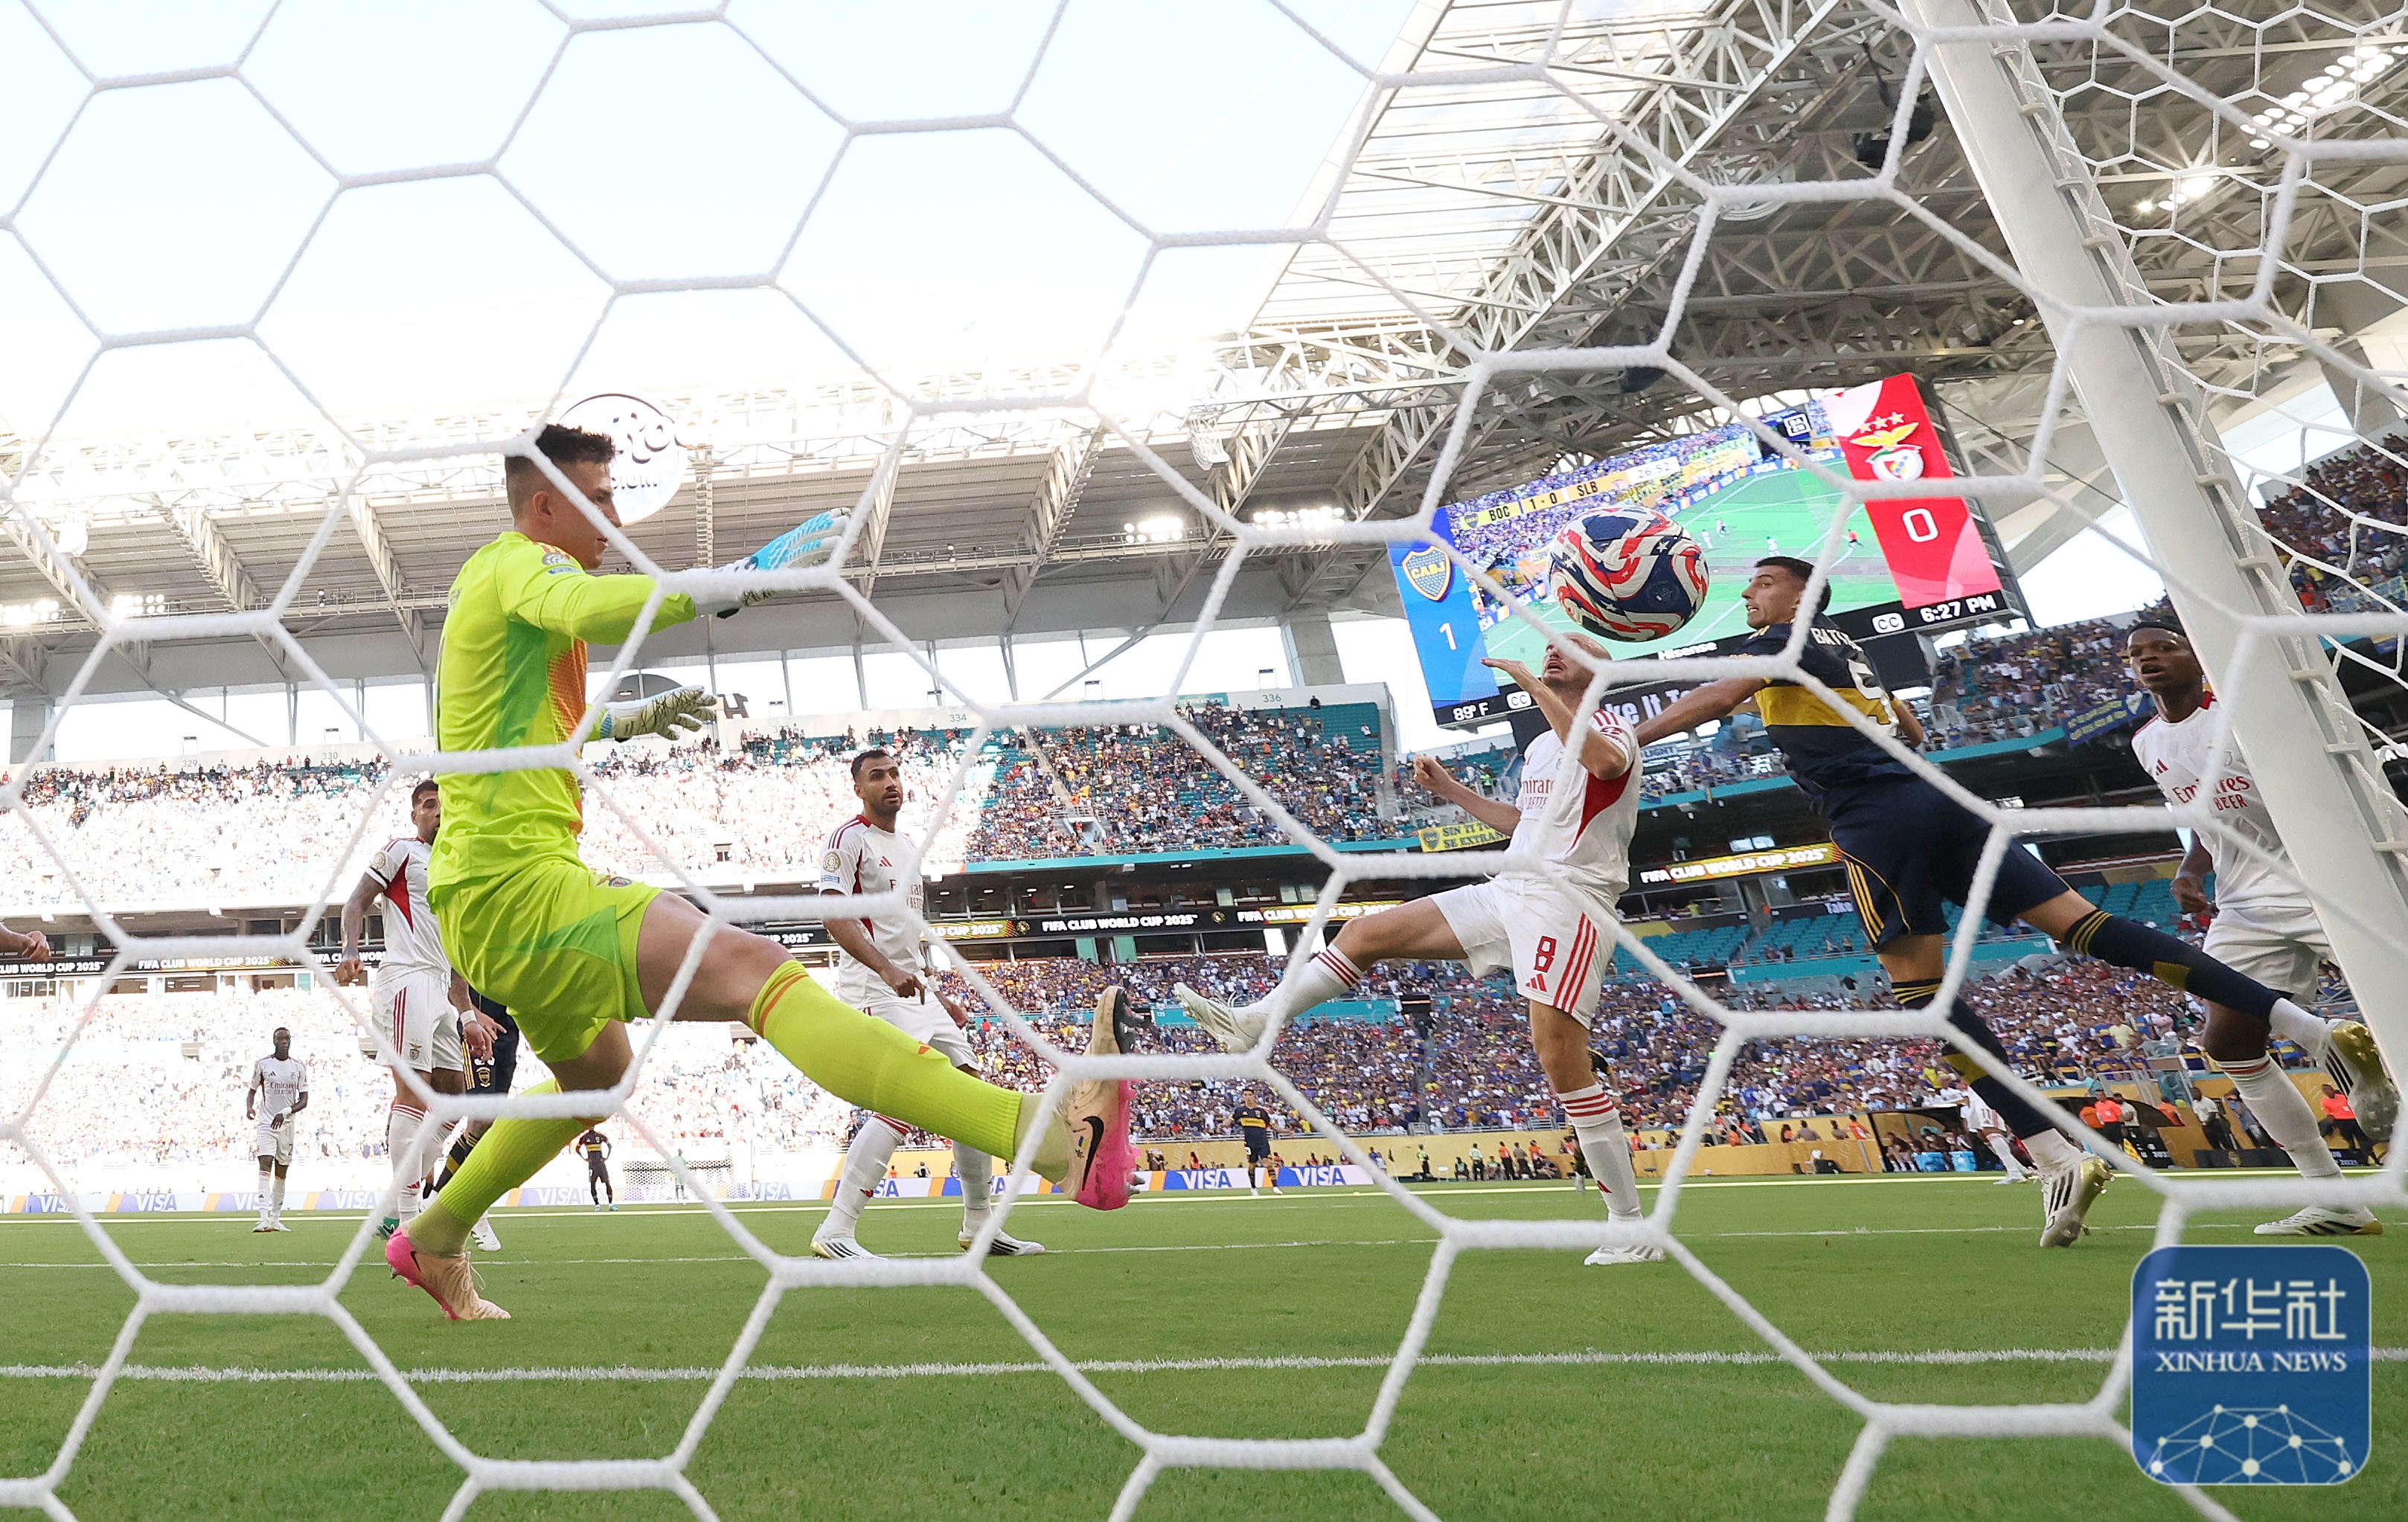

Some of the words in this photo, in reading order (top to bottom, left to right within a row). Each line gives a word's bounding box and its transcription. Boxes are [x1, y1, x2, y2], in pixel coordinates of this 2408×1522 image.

[1639, 462, 1671, 478] 26:52
[1578, 481, 1598, 497] SLB
[1488, 506, 1511, 521] BOC
[1902, 508, 1938, 542] 0
[1410, 560, 1445, 579] CABJ
[1878, 616, 1899, 631] CC
[1921, 602, 1961, 623] 6:27
[1966, 594, 1996, 614] PM
[1439, 623, 1457, 651] 1
[1658, 641, 1717, 661] Hisense
[1262, 694, 1281, 702] 336
[1478, 701, 1489, 716] F
[1511, 694, 1528, 706] CC
[949, 714, 967, 722] 334
[620, 745, 637, 754] 332
[1451, 742, 1469, 754] 337
[1442, 826, 1461, 837] SIN
[1640, 869, 1671, 884] FIFA
[1670, 864, 1706, 879] CLUB
[1705, 858, 1756, 876] WORLD
[1756, 854, 1785, 868] CUP
[1237, 911, 1264, 922] FIFA
[1264, 909, 1295, 921] CLUB
[1338, 905, 1362, 917] CUP
[948, 925, 970, 936] CUP
[1042, 920, 1068, 932] FIFA
[1067, 919, 1098, 930] CLUB
[1098, 916, 1140, 929] WORLD
[1140, 915, 1163, 926] CUP
[1534, 935, 1557, 973] 8
[20, 963, 55, 974] WORLD
[56, 962, 76, 972] CUP
[138, 960, 159, 970] FIFA
[161, 958, 185, 969] CLUB
[188, 957, 222, 967] WORLD
[222, 957, 243, 966] CUP
[1177, 1169, 1232, 1189] VISA
[1289, 1166, 1346, 1187] VISA
[135, 1194, 178, 1212] VISA
[334, 1191, 377, 1210] VISA
[537, 1187, 582, 1206] VISA
